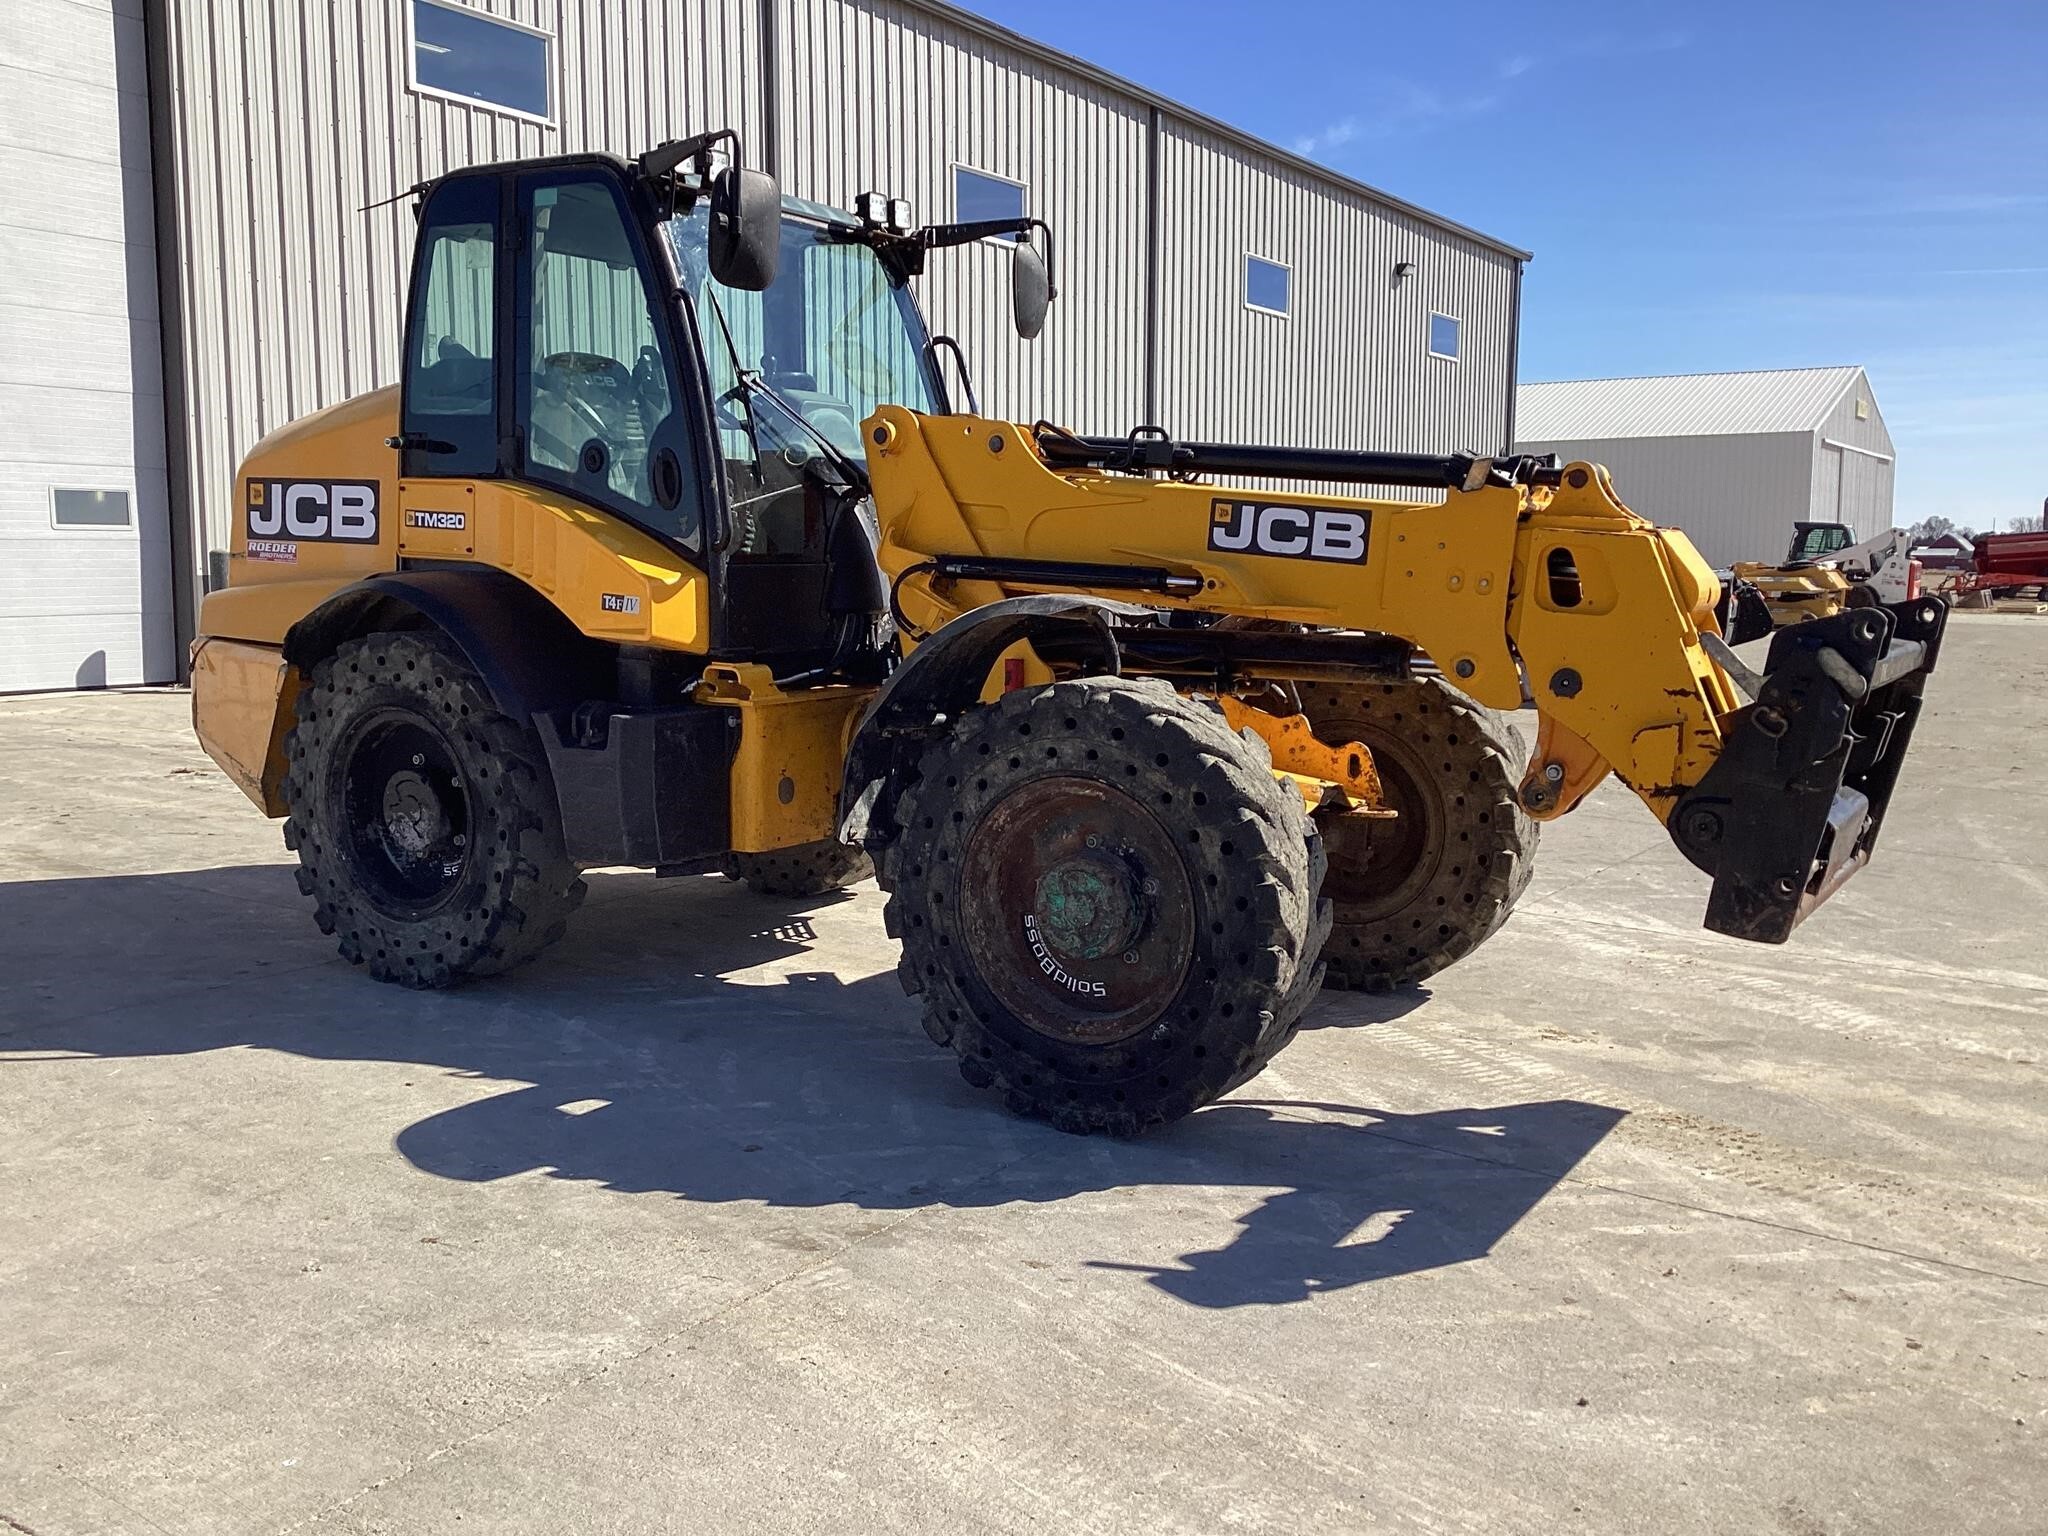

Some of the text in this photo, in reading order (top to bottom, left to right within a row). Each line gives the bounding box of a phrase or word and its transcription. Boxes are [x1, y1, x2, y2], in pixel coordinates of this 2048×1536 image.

[249, 483, 376, 539] JCB
[415, 512, 465, 530] TM320
[248, 542, 296, 553] ROEDER
[1213, 505, 1365, 560] JCB
